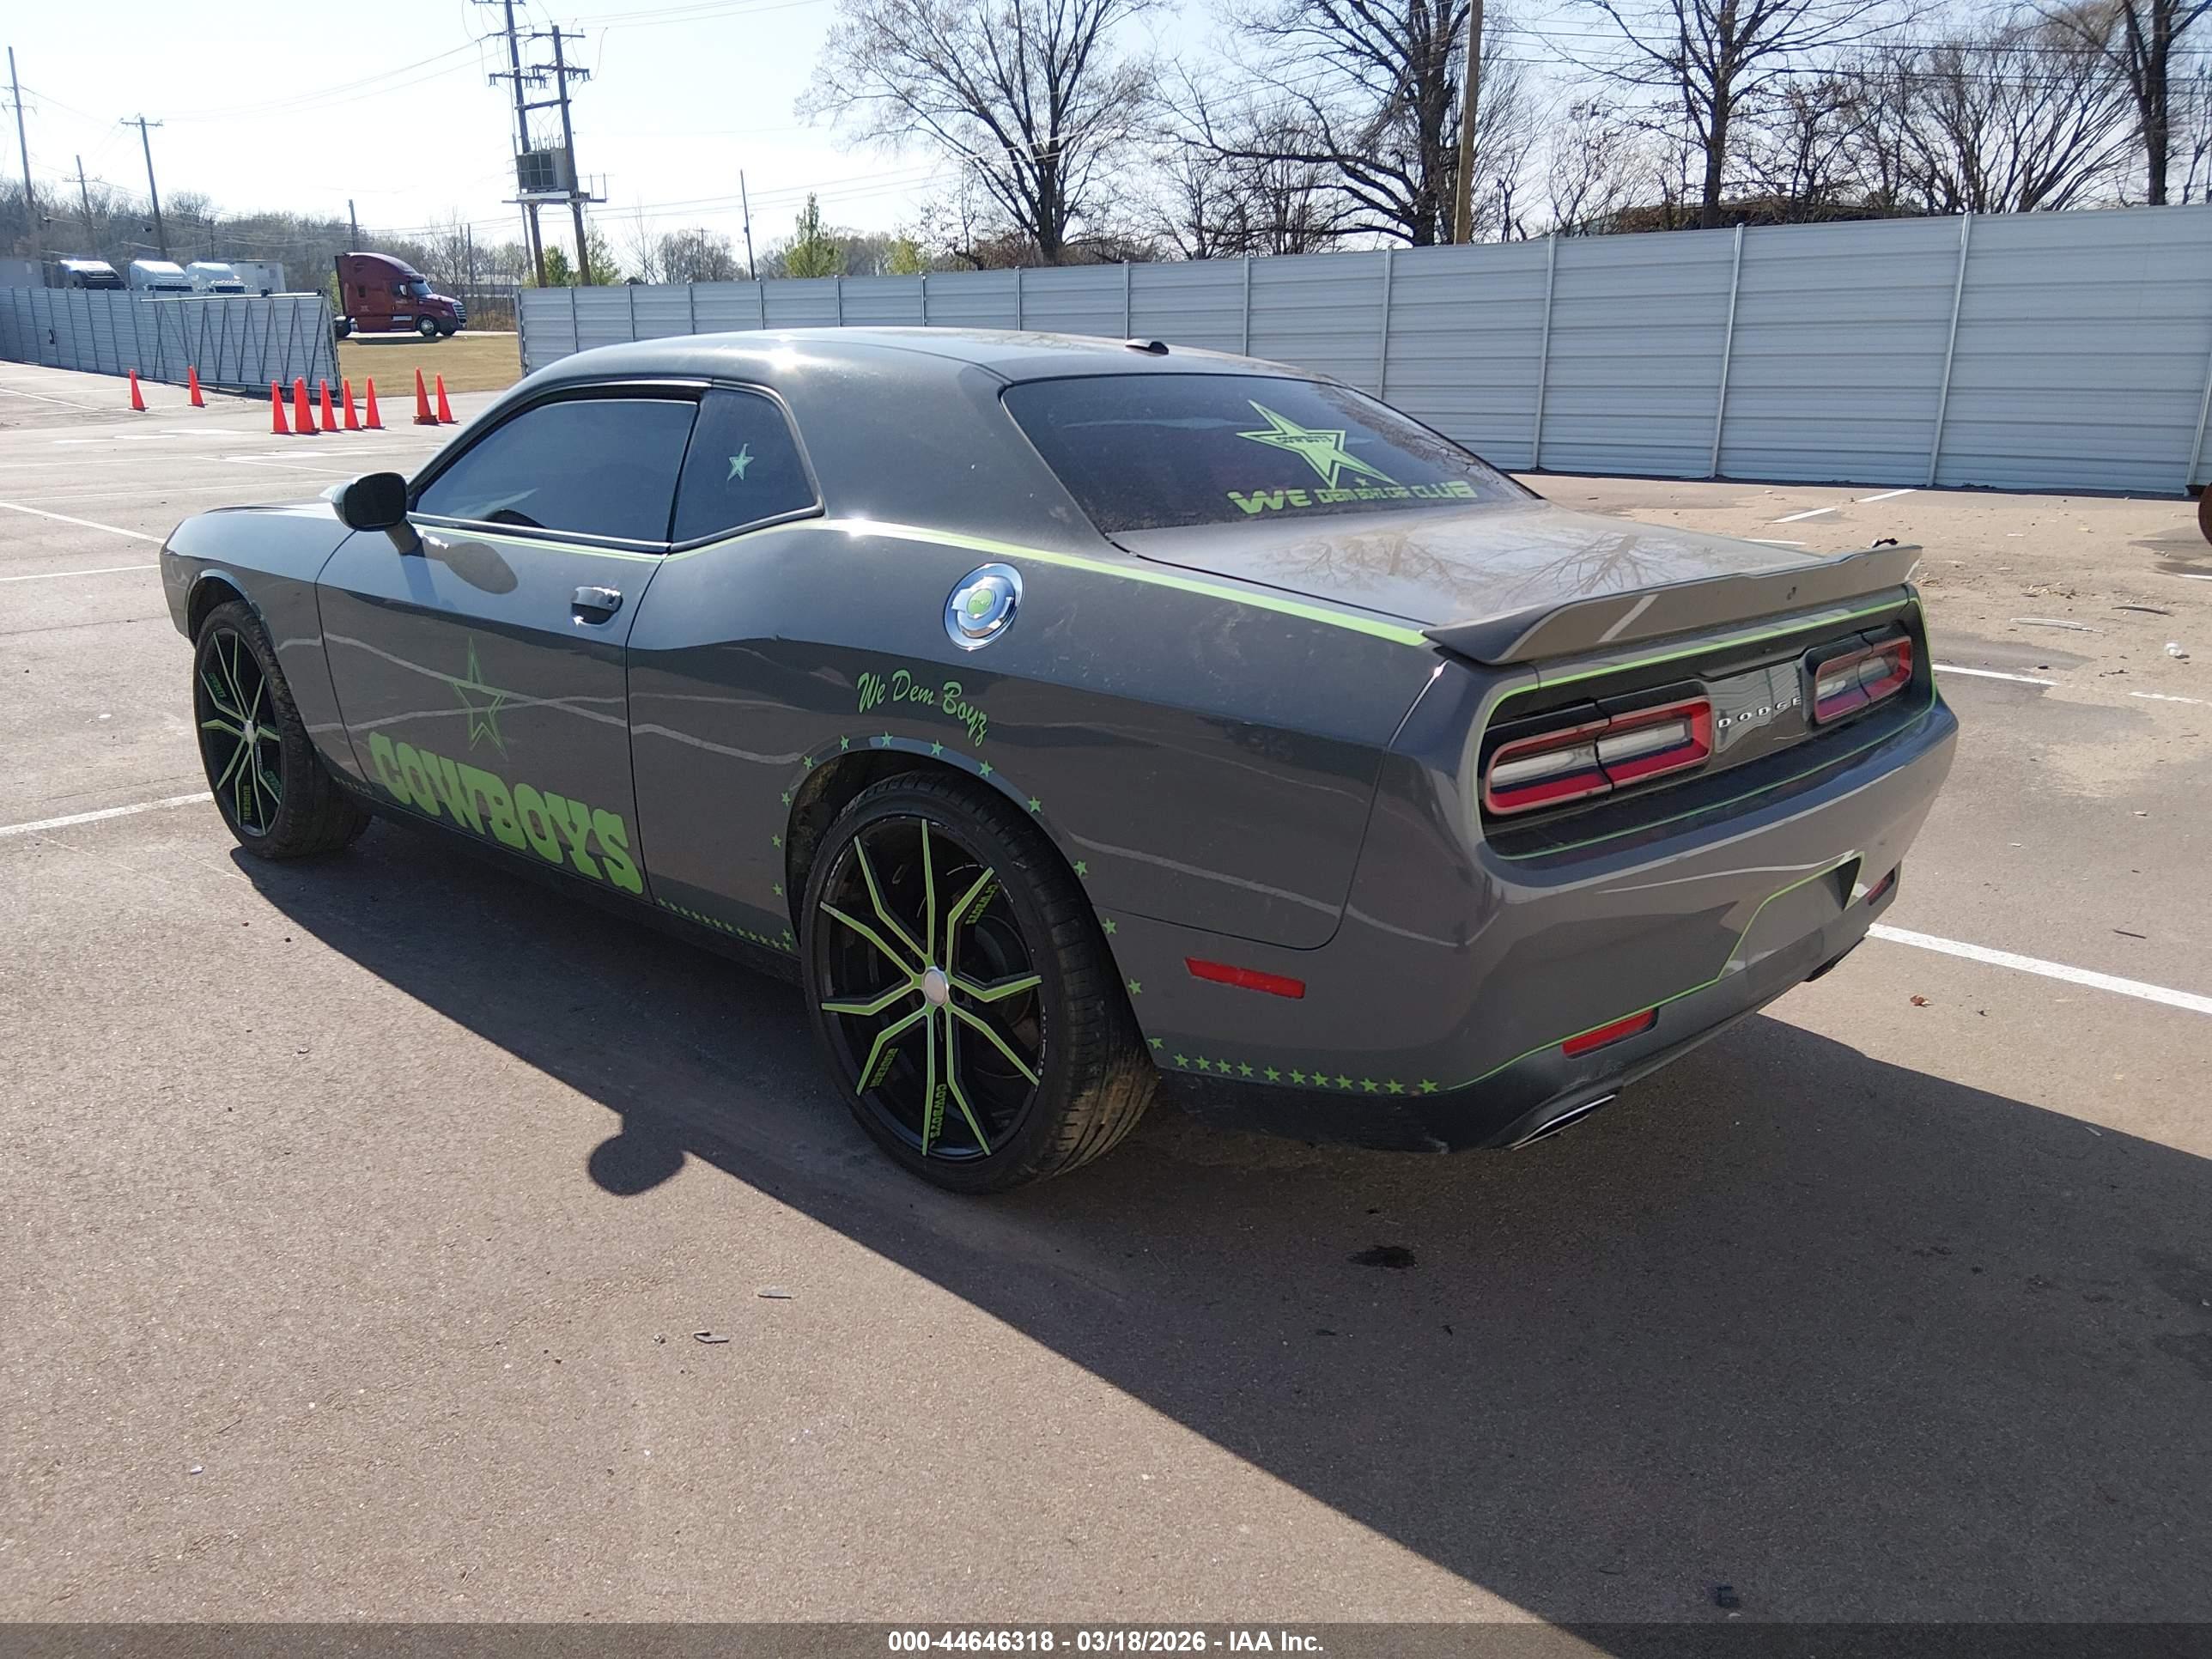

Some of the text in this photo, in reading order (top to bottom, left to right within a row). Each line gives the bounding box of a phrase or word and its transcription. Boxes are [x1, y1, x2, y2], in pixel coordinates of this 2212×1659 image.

[1227, 489, 1313, 514] WE
[1410, 480, 1478, 498] CLUB
[857, 669, 988, 747] We Dem Boyz
[1717, 696, 1802, 728] DODGE
[368, 731, 643, 895] COWBOYS
